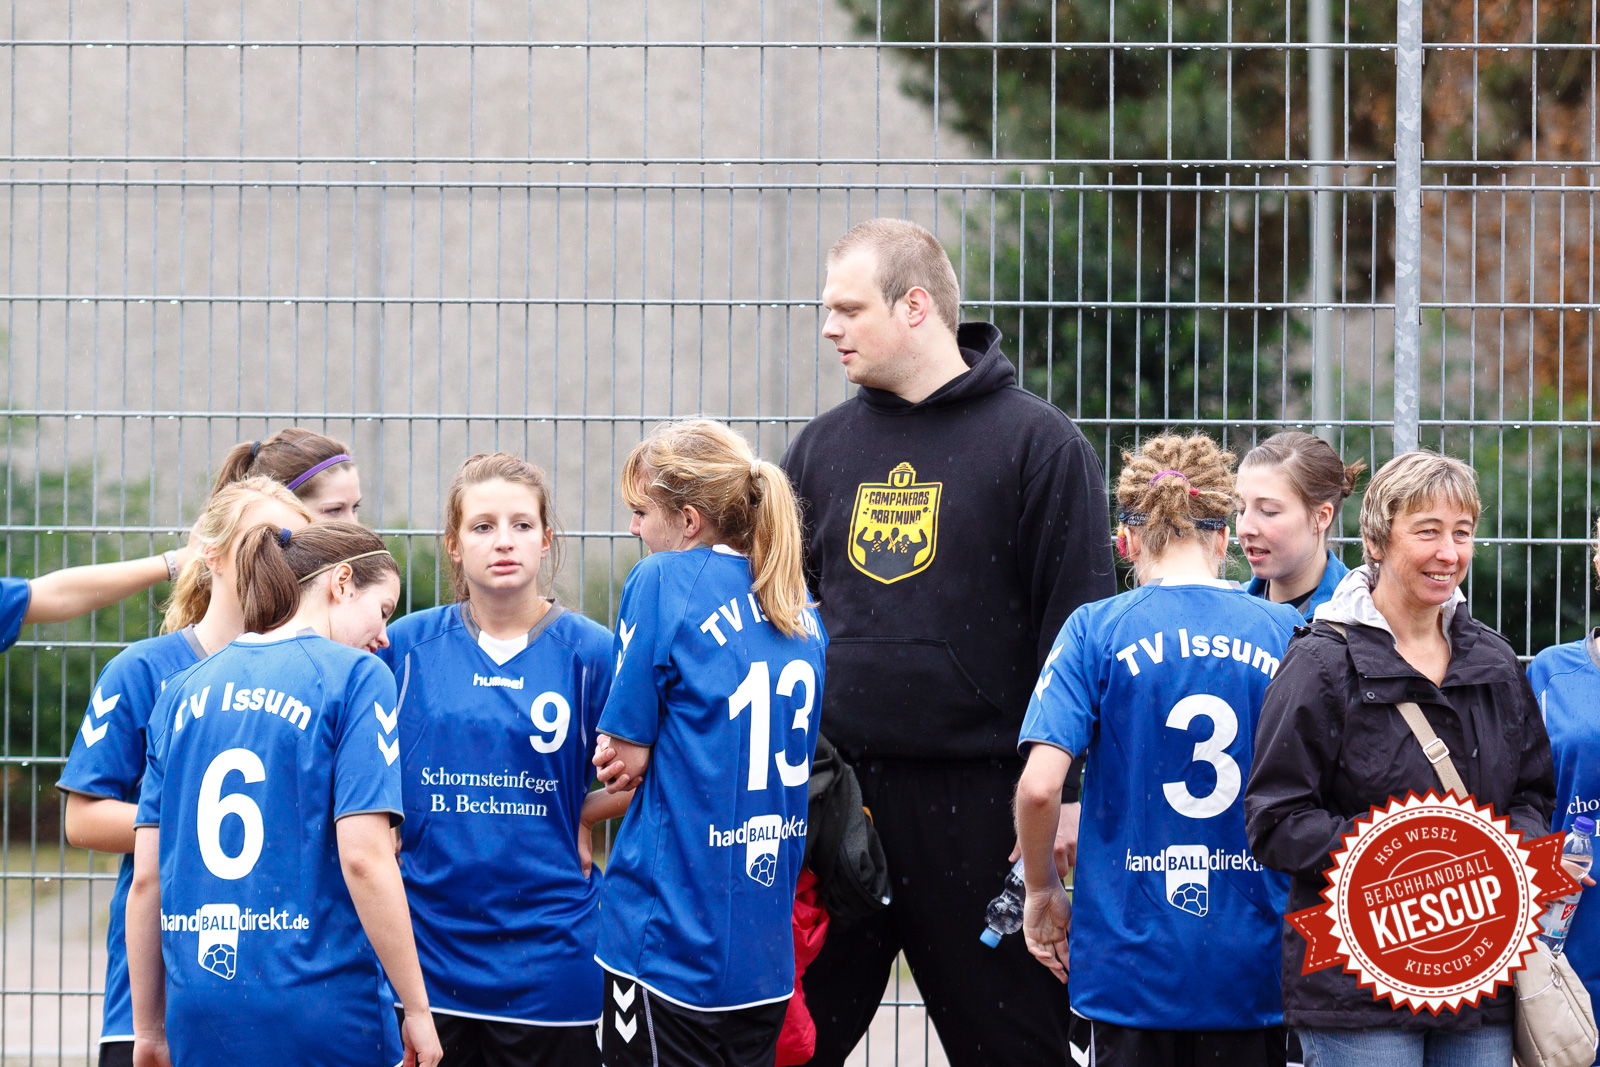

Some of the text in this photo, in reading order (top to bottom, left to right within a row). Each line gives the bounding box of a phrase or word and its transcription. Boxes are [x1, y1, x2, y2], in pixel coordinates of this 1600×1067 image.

[870, 509, 922, 525] DORTMUND
[699, 597, 744, 647] TV
[1115, 628, 1280, 679] TV Issum
[221, 682, 312, 731] Issum
[473, 673, 524, 690] hummel
[529, 691, 571, 754] 9
[728, 659, 816, 791] 13
[421, 767, 558, 794] Schornsteinfeger
[1162, 693, 1242, 819] 3
[197, 747, 266, 880] 6
[430, 794, 548, 817] B. Beckmann
